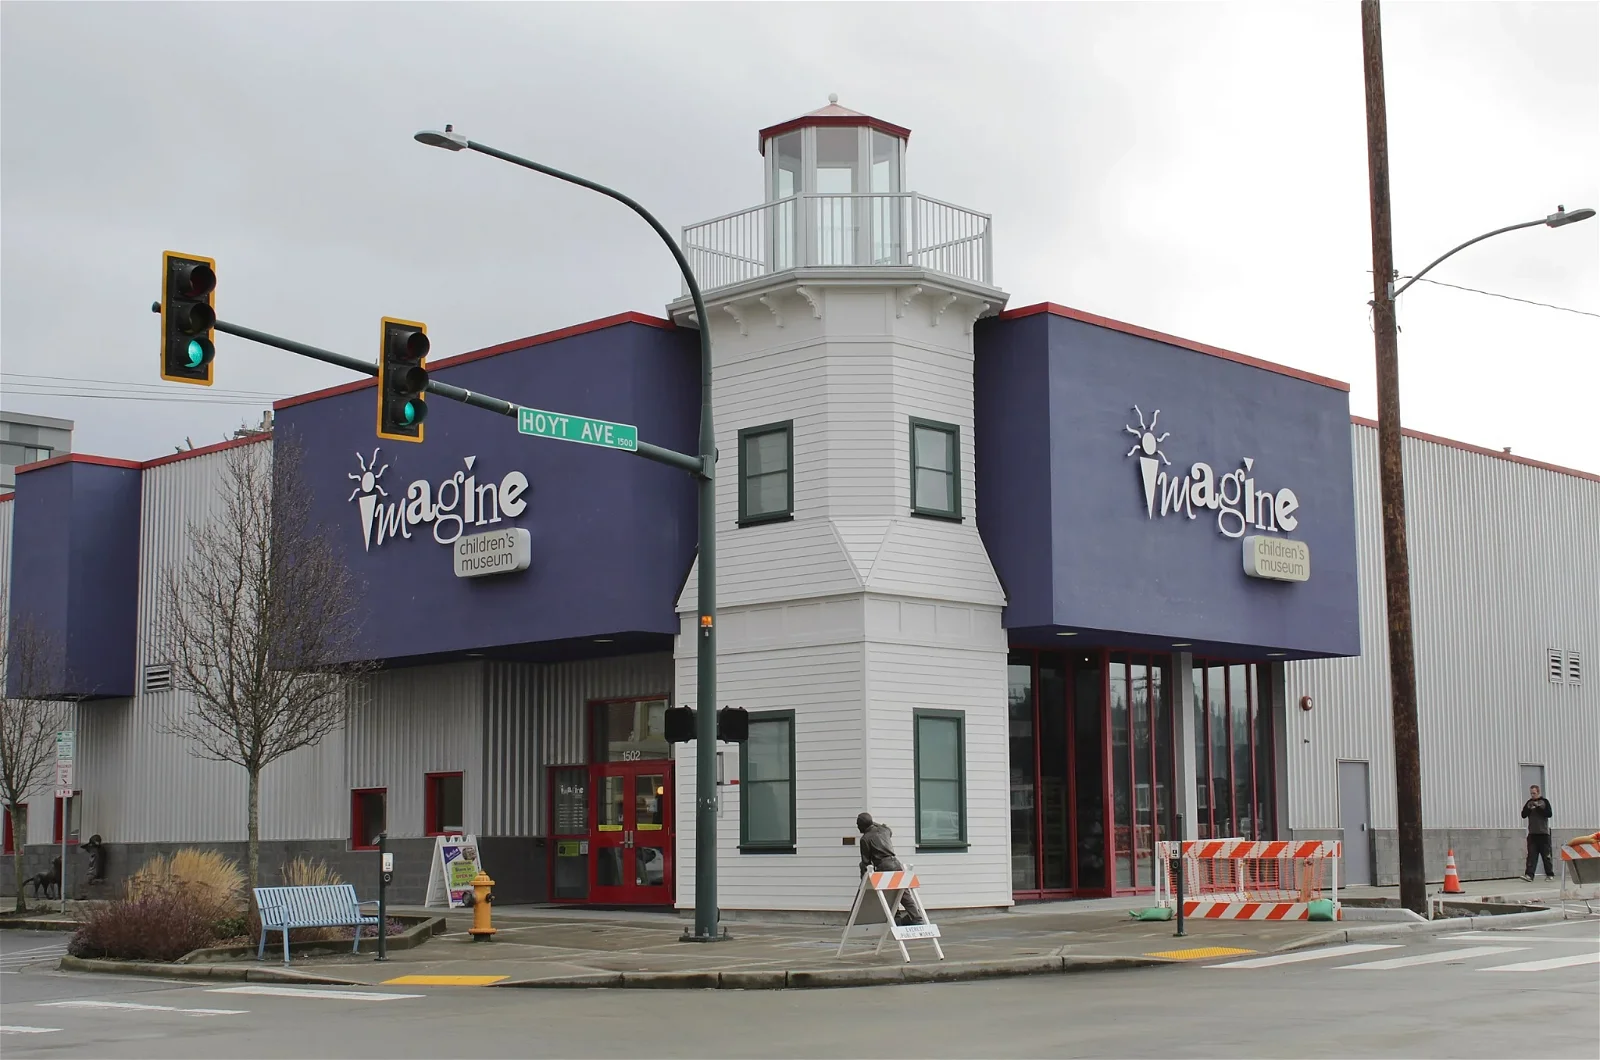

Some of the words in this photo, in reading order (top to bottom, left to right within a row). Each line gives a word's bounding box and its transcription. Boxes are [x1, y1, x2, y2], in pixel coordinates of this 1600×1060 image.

[522, 411, 569, 437] HOYT
[581, 421, 614, 444] AVE
[617, 437, 633, 447] 1500
[1125, 405, 1300, 538] imagine
[348, 448, 529, 552] imagine
[460, 532, 515, 556] children's
[1258, 539, 1305, 561] children's
[461, 552, 513, 572] museum
[1260, 558, 1304, 576] museum
[622, 750, 641, 762] 1502
